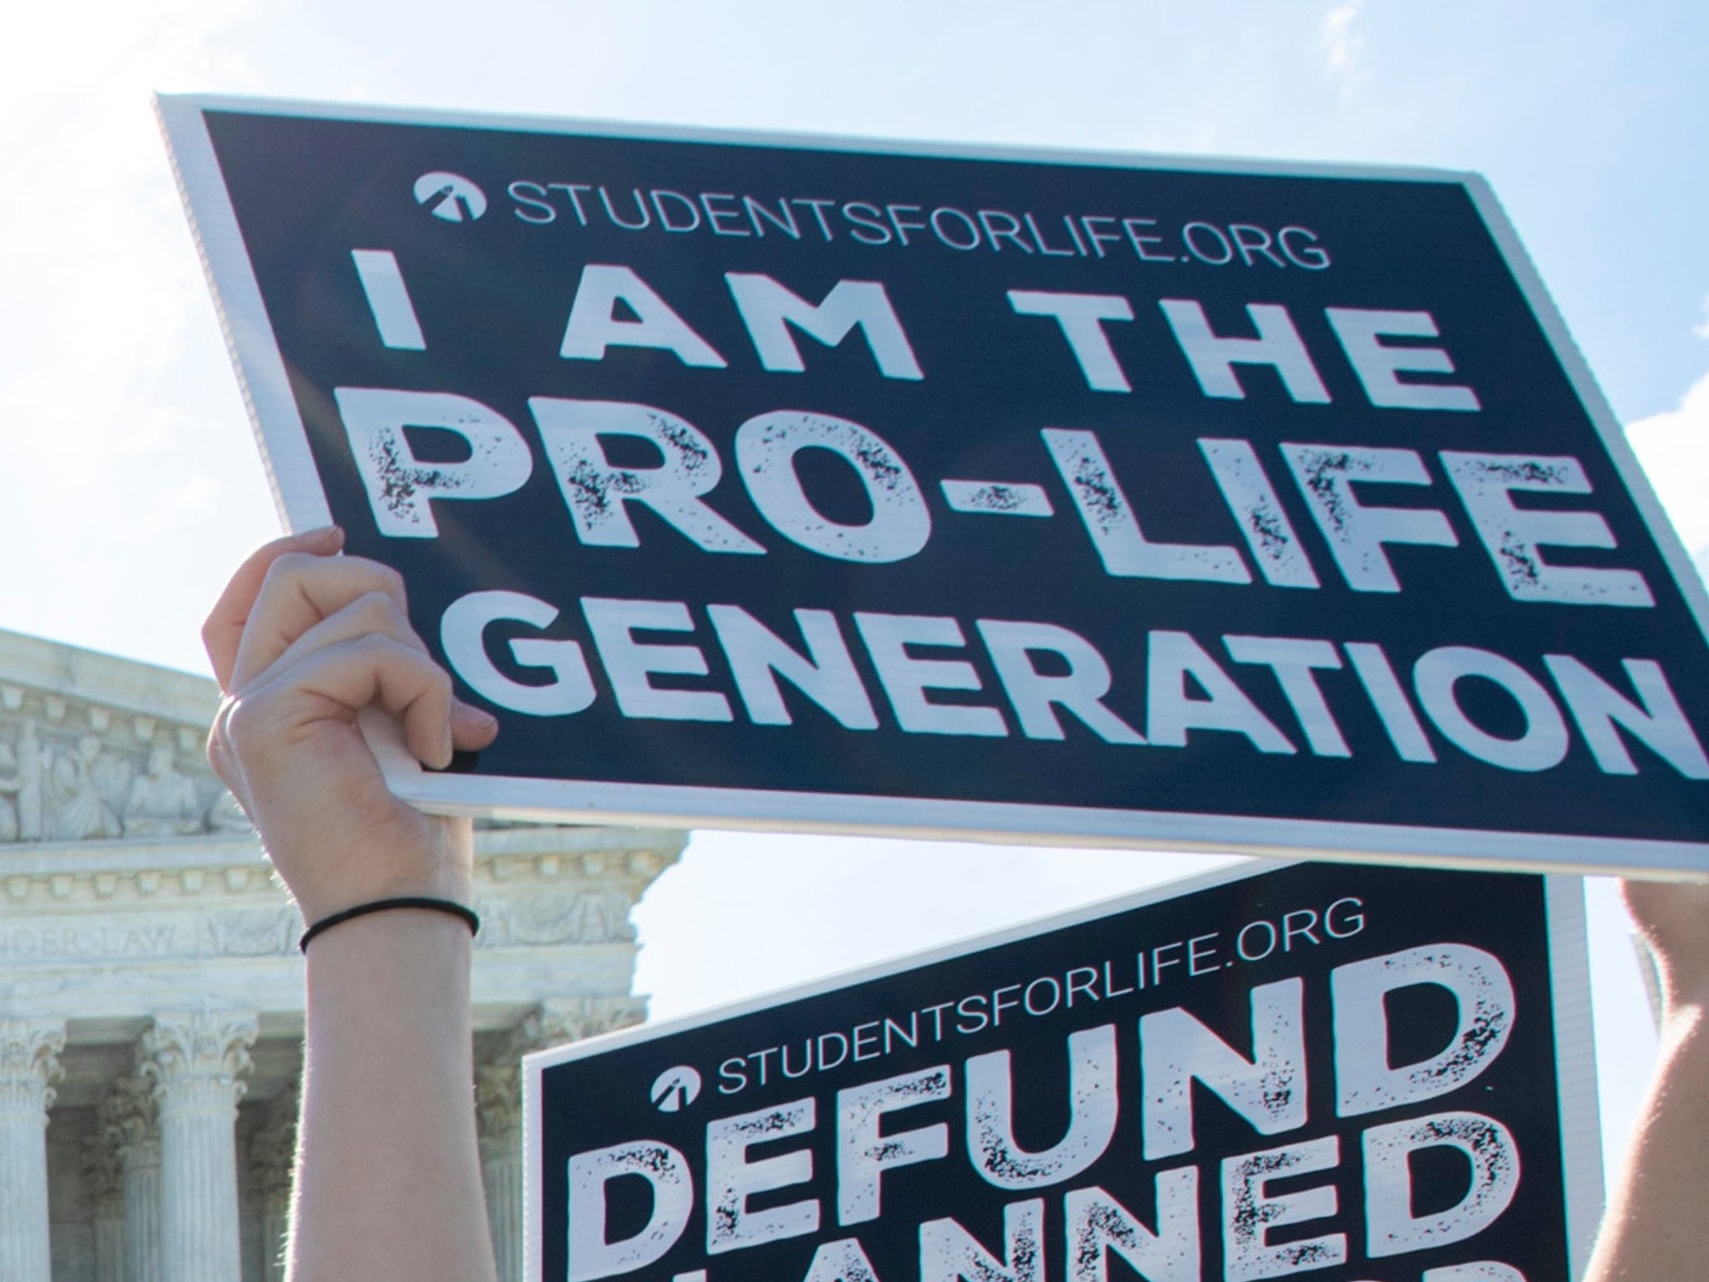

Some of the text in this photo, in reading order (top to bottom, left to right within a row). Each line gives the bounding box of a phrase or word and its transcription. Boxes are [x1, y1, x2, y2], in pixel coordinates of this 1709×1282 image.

[507, 176, 1330, 274] STUDENTSFORLIFE.ORG
[350, 247, 1481, 412] I AM THE
[334, 386, 1656, 607] PRO-LIFE
[439, 589, 1709, 780] GENERATION
[101, 924, 179, 954] LAW
[718, 896, 1368, 1096] STUDENTSFORLIFE.ORG
